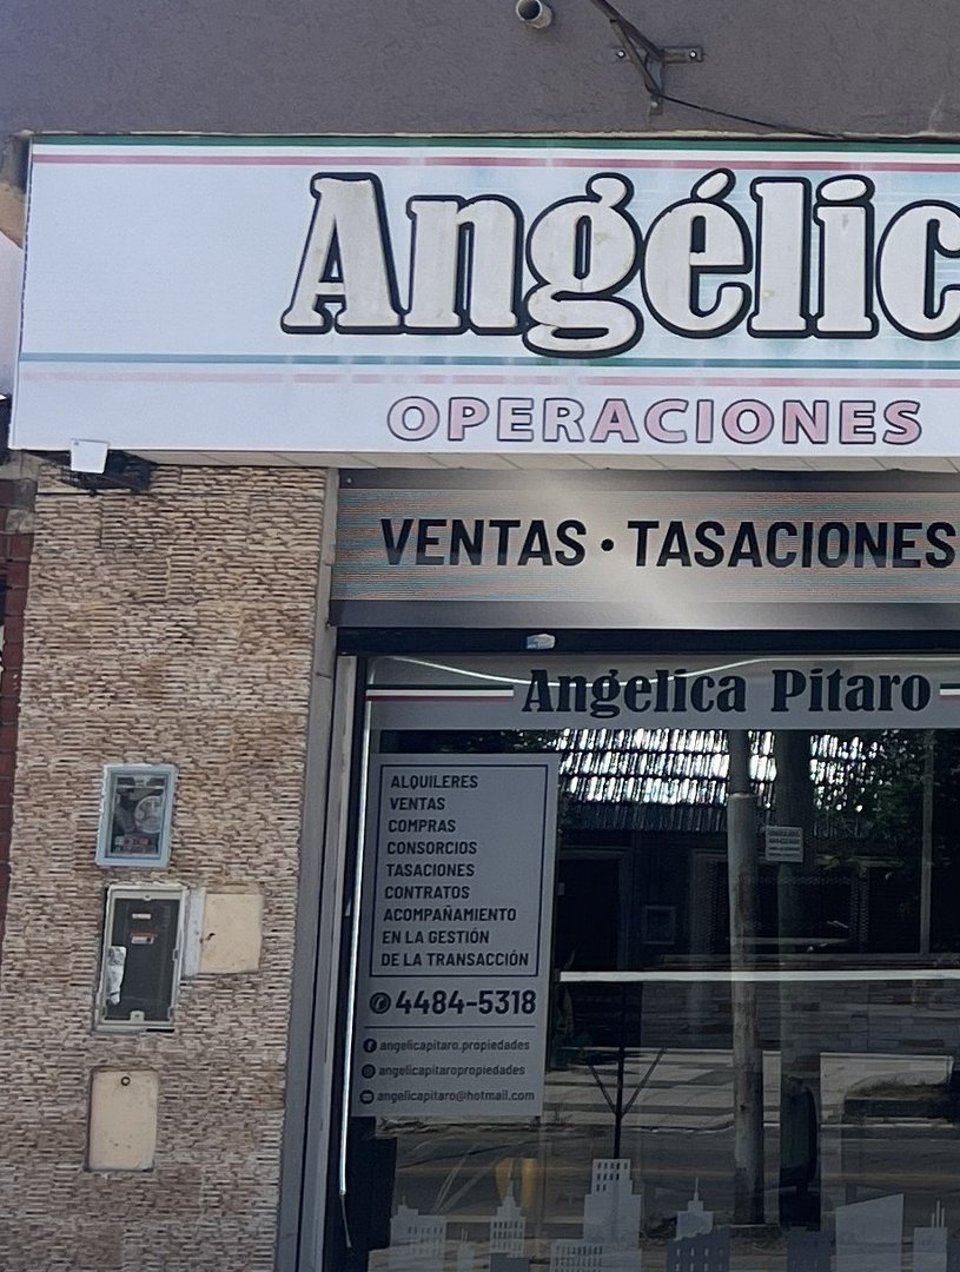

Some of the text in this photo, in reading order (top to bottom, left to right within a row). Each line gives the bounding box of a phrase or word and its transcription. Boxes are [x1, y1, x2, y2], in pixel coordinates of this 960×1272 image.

[386, 395, 923, 446] OPERACIONES
[381, 518, 586, 568] VENTAS
[636, 519, 957, 568] TASACIONES
[770, 668, 931, 713] Pitaro
[391, 775, 478, 789] ALQUILERES
[390, 797, 446, 810] VENTAS
[388, 819, 457, 833] COMPRAS
[387, 841, 478, 855] CONSORCIOS
[386, 863, 475, 877] TASACIONES
[384, 886, 471, 899] CONTRATOS
[383, 905, 517, 922] ACOMPAÑAMIENTO
[382, 927, 490, 944] EN LA GESTIÓN
[381, 950, 529, 966] DE LA TRANSACCIÓN
[395, 990, 537, 1015] 4484-5318
[379, 1039, 531, 1054] angelicapitaro.propiedades
[378, 1064, 526, 1079] angelicapitaropropiedades
[377, 1089, 536, 1104] angelicapitaro@hotmail.com
